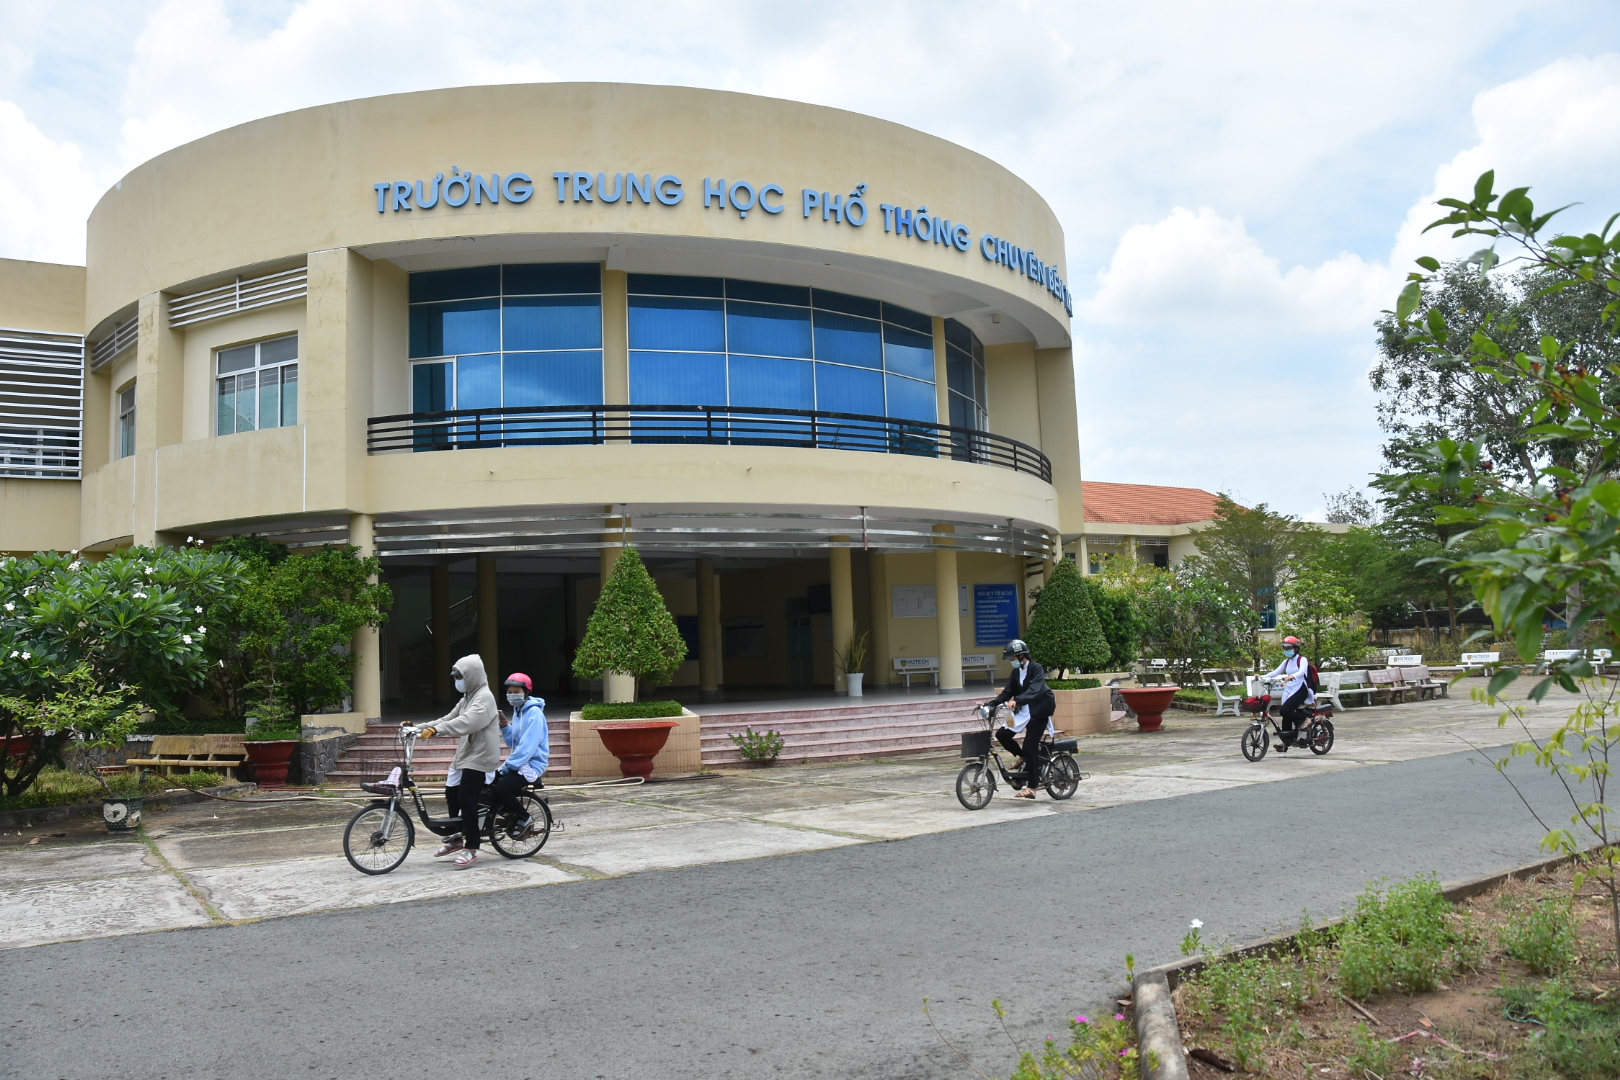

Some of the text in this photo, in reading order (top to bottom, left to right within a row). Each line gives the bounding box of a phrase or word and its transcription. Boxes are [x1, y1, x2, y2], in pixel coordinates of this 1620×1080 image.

[373, 165, 535, 213] TRƯỜNG
[552, 171, 685, 206] TRUNG
[703, 177, 785, 219] HỌC
[802, 182, 869, 227] PHỔ
[880, 204, 972, 252] THÔNG
[980, 233, 1046, 285] CHUYÊN
